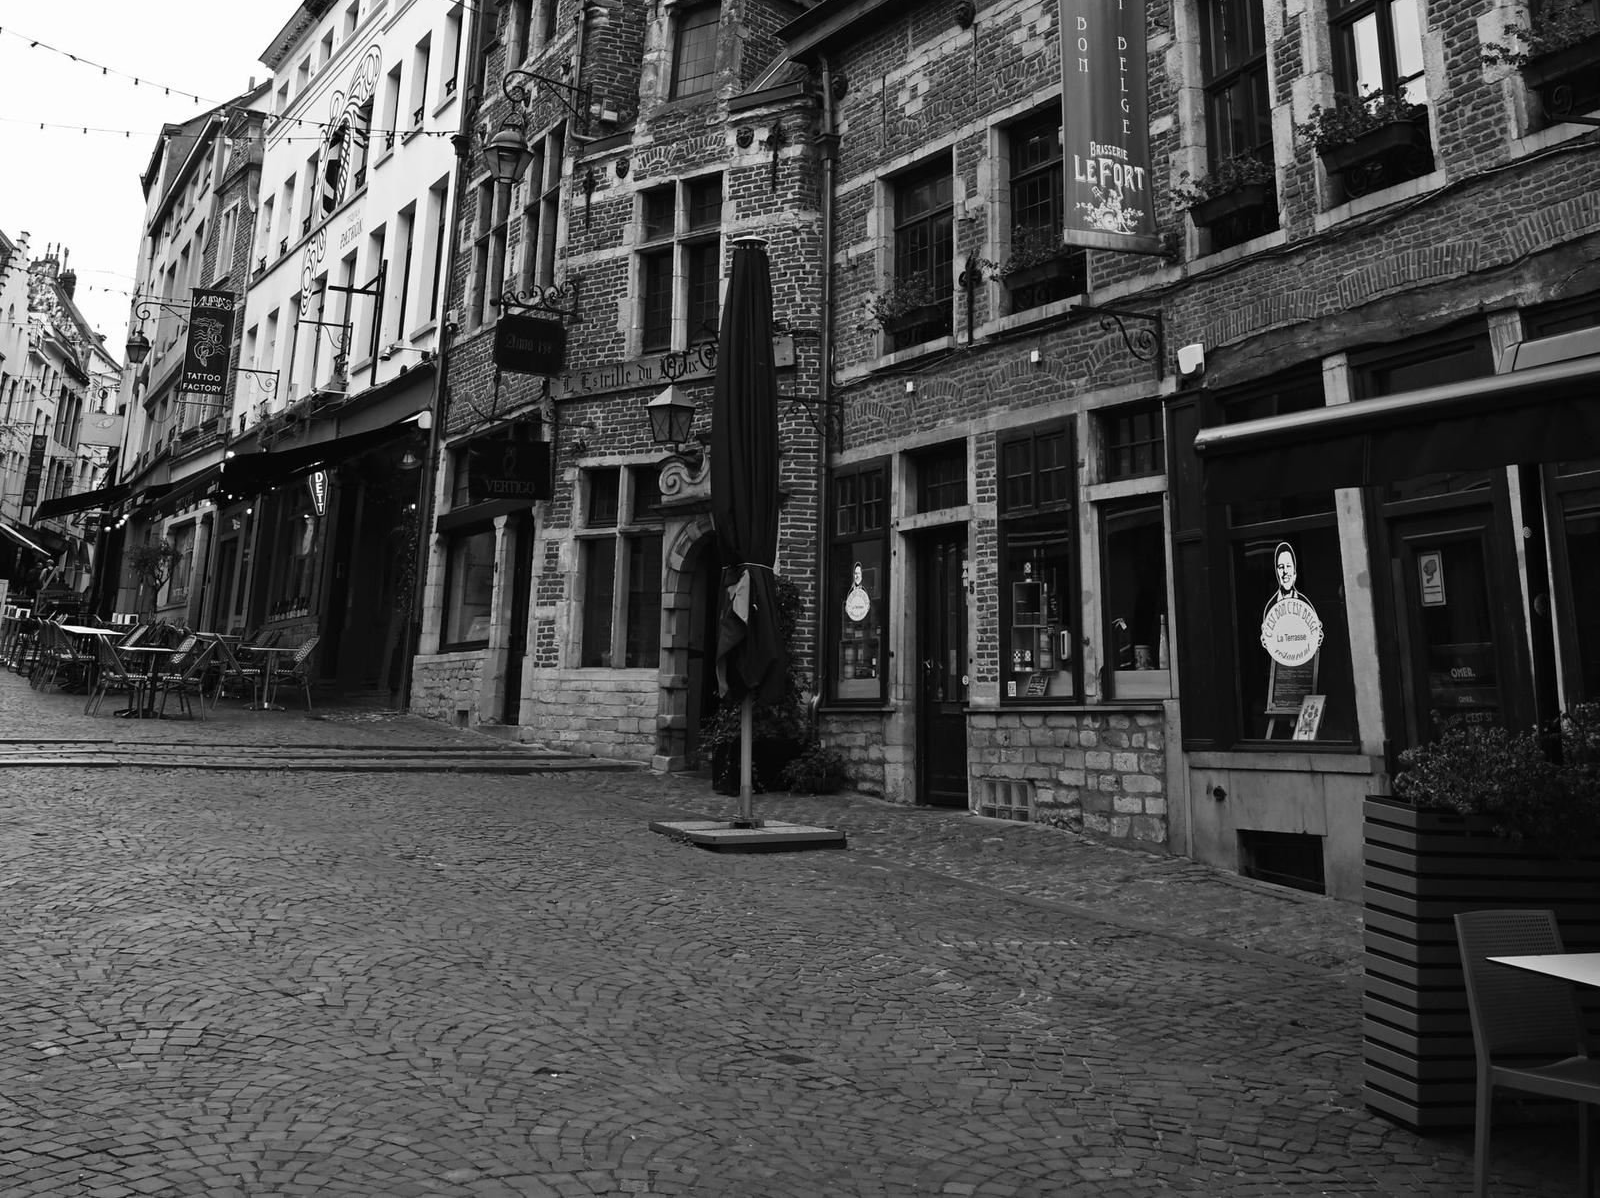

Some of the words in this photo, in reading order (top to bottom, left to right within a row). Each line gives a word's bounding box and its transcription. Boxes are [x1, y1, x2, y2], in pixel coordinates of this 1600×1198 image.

[1076, 16, 1089, 74] BON
[1117, 36, 1131, 135] BELGE
[187, 372, 221, 382] TATTOO
[638, 363, 653, 381] du
[182, 382, 222, 393] FACTORY
[486, 479, 536, 495] VERTIGO
[969, 581, 975, 594] 5
[1274, 603, 1287, 620] BON
[1302, 607, 1318, 636] BELGE
[1276, 634, 1284, 643] La
[1285, 633, 1307, 643] Terrasse
[1275, 644, 1310, 660] restaurant
